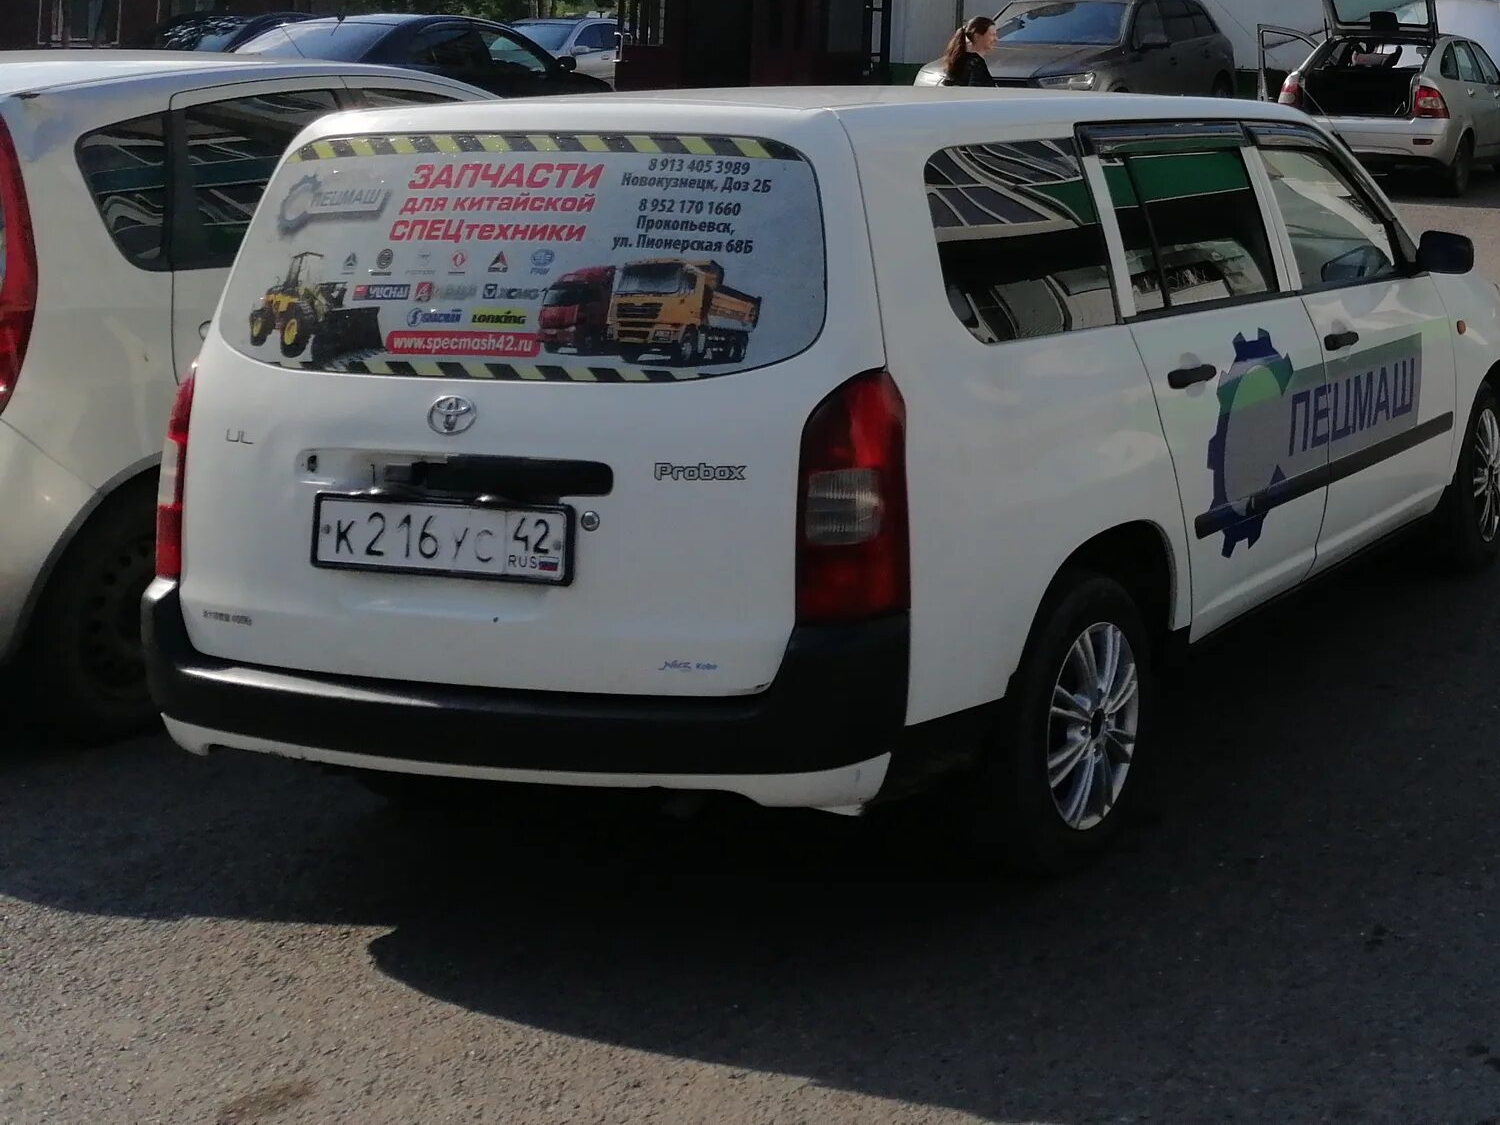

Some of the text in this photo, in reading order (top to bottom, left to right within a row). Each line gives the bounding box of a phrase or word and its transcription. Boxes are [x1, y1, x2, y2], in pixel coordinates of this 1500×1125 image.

[408, 163, 604, 190] ЗАПЧАСТИ
[648, 158, 750, 175] 8 913 405 3989
[621, 172, 772, 194] Новокузнецк, Доз 2Б
[399, 192, 596, 215] для китайской
[638, 198, 741, 216] 8 952 170 1660
[389, 219, 586, 244] СПЕЦтехники
[636, 215, 736, 235] Прокопьевск,
[612, 234, 753, 254] ул. Пионерская 68Б
[393, 334, 533, 353] www.specmash42.ru
[654, 462, 747, 481] Probox
[512, 516, 549, 554] 42
[508, 554, 538, 570] RUS
